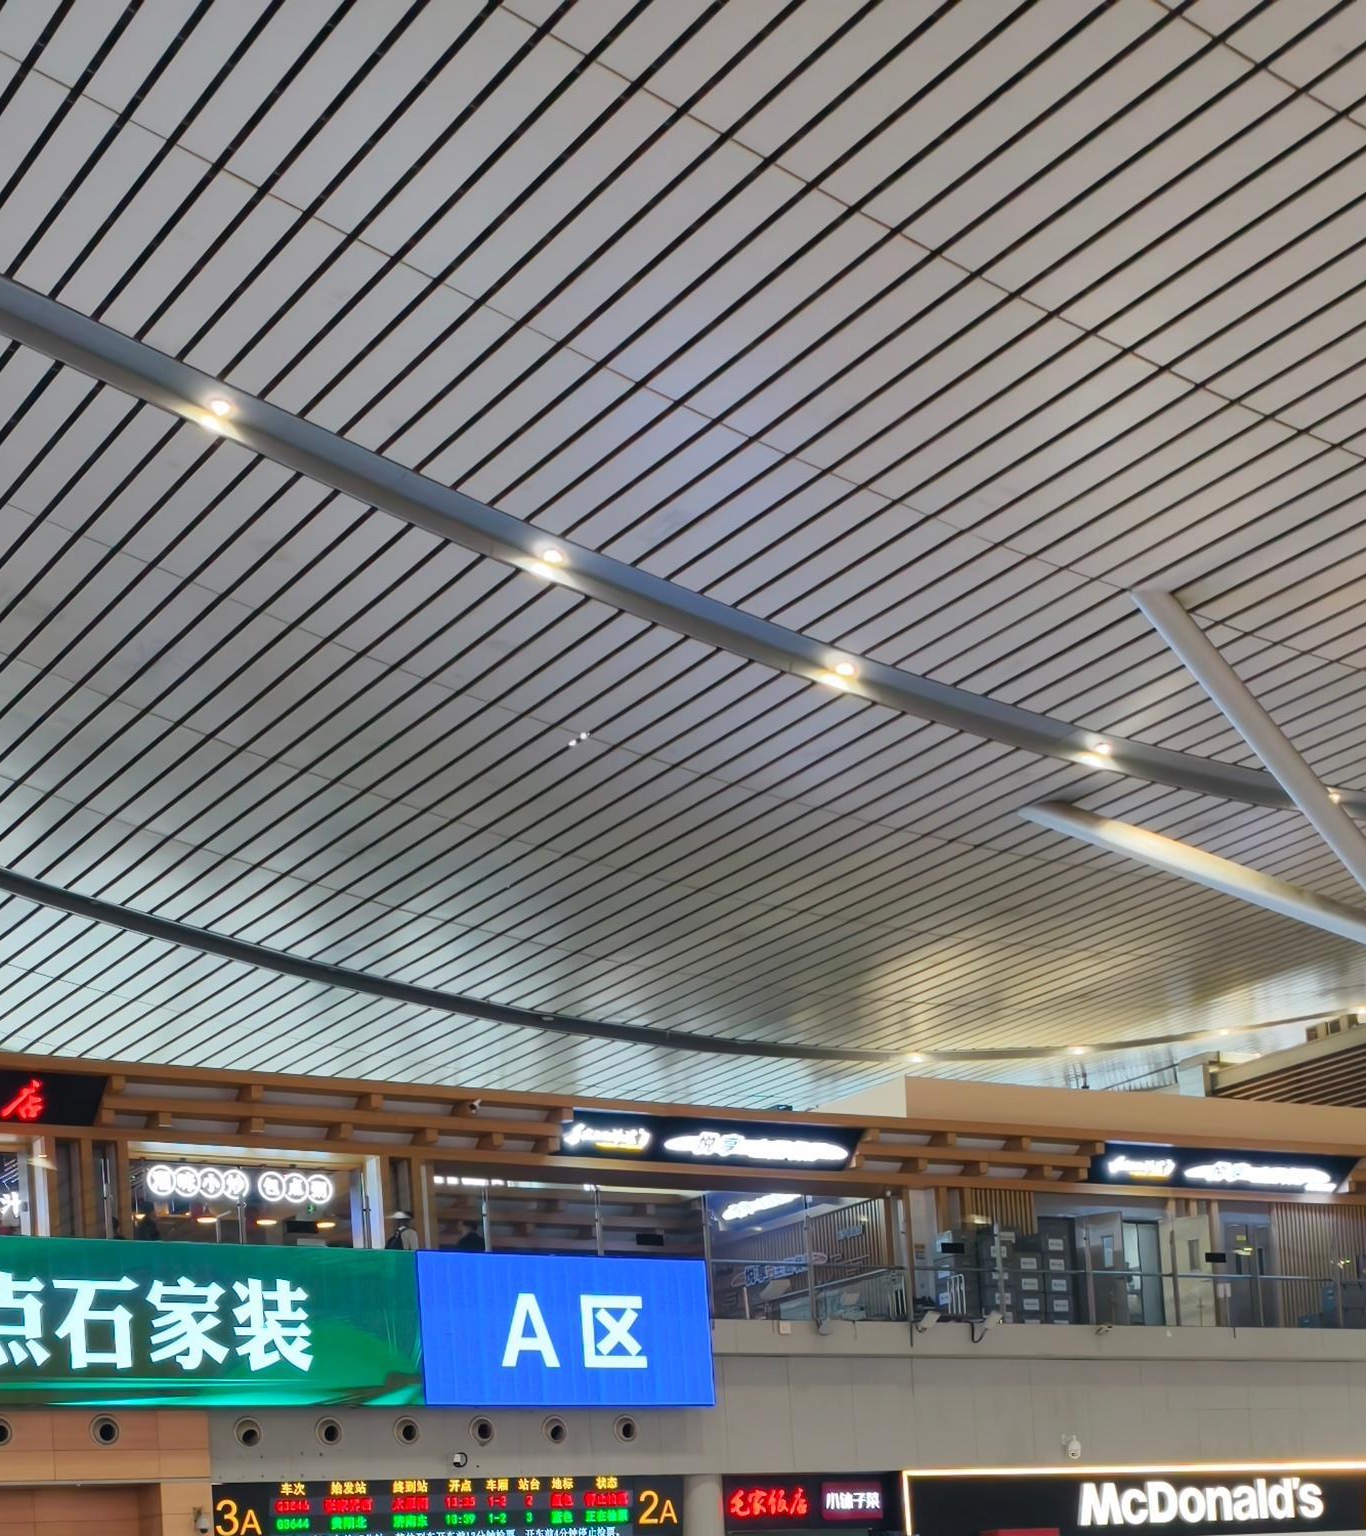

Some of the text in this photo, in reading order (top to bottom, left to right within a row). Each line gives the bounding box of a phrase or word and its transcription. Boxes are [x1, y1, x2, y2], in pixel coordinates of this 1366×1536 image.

[280, 1483, 306, 1496] 车次
[330, 1481, 367, 1495] 始发站
[392, 1480, 428, 1494] 终到站
[448, 1479, 472, 1492] 开点
[518, 1477, 541, 1491] 站台
[551, 1477, 574, 1490] 地标
[595, 1476, 618, 1490] 状态
[730, 1487, 808, 1517] 毛家饭店
[1077, 1478, 1324, 1527] McDonald's
[215, 1499, 263, 1536] 3A
[639, 1489, 679, 1525] 2A
